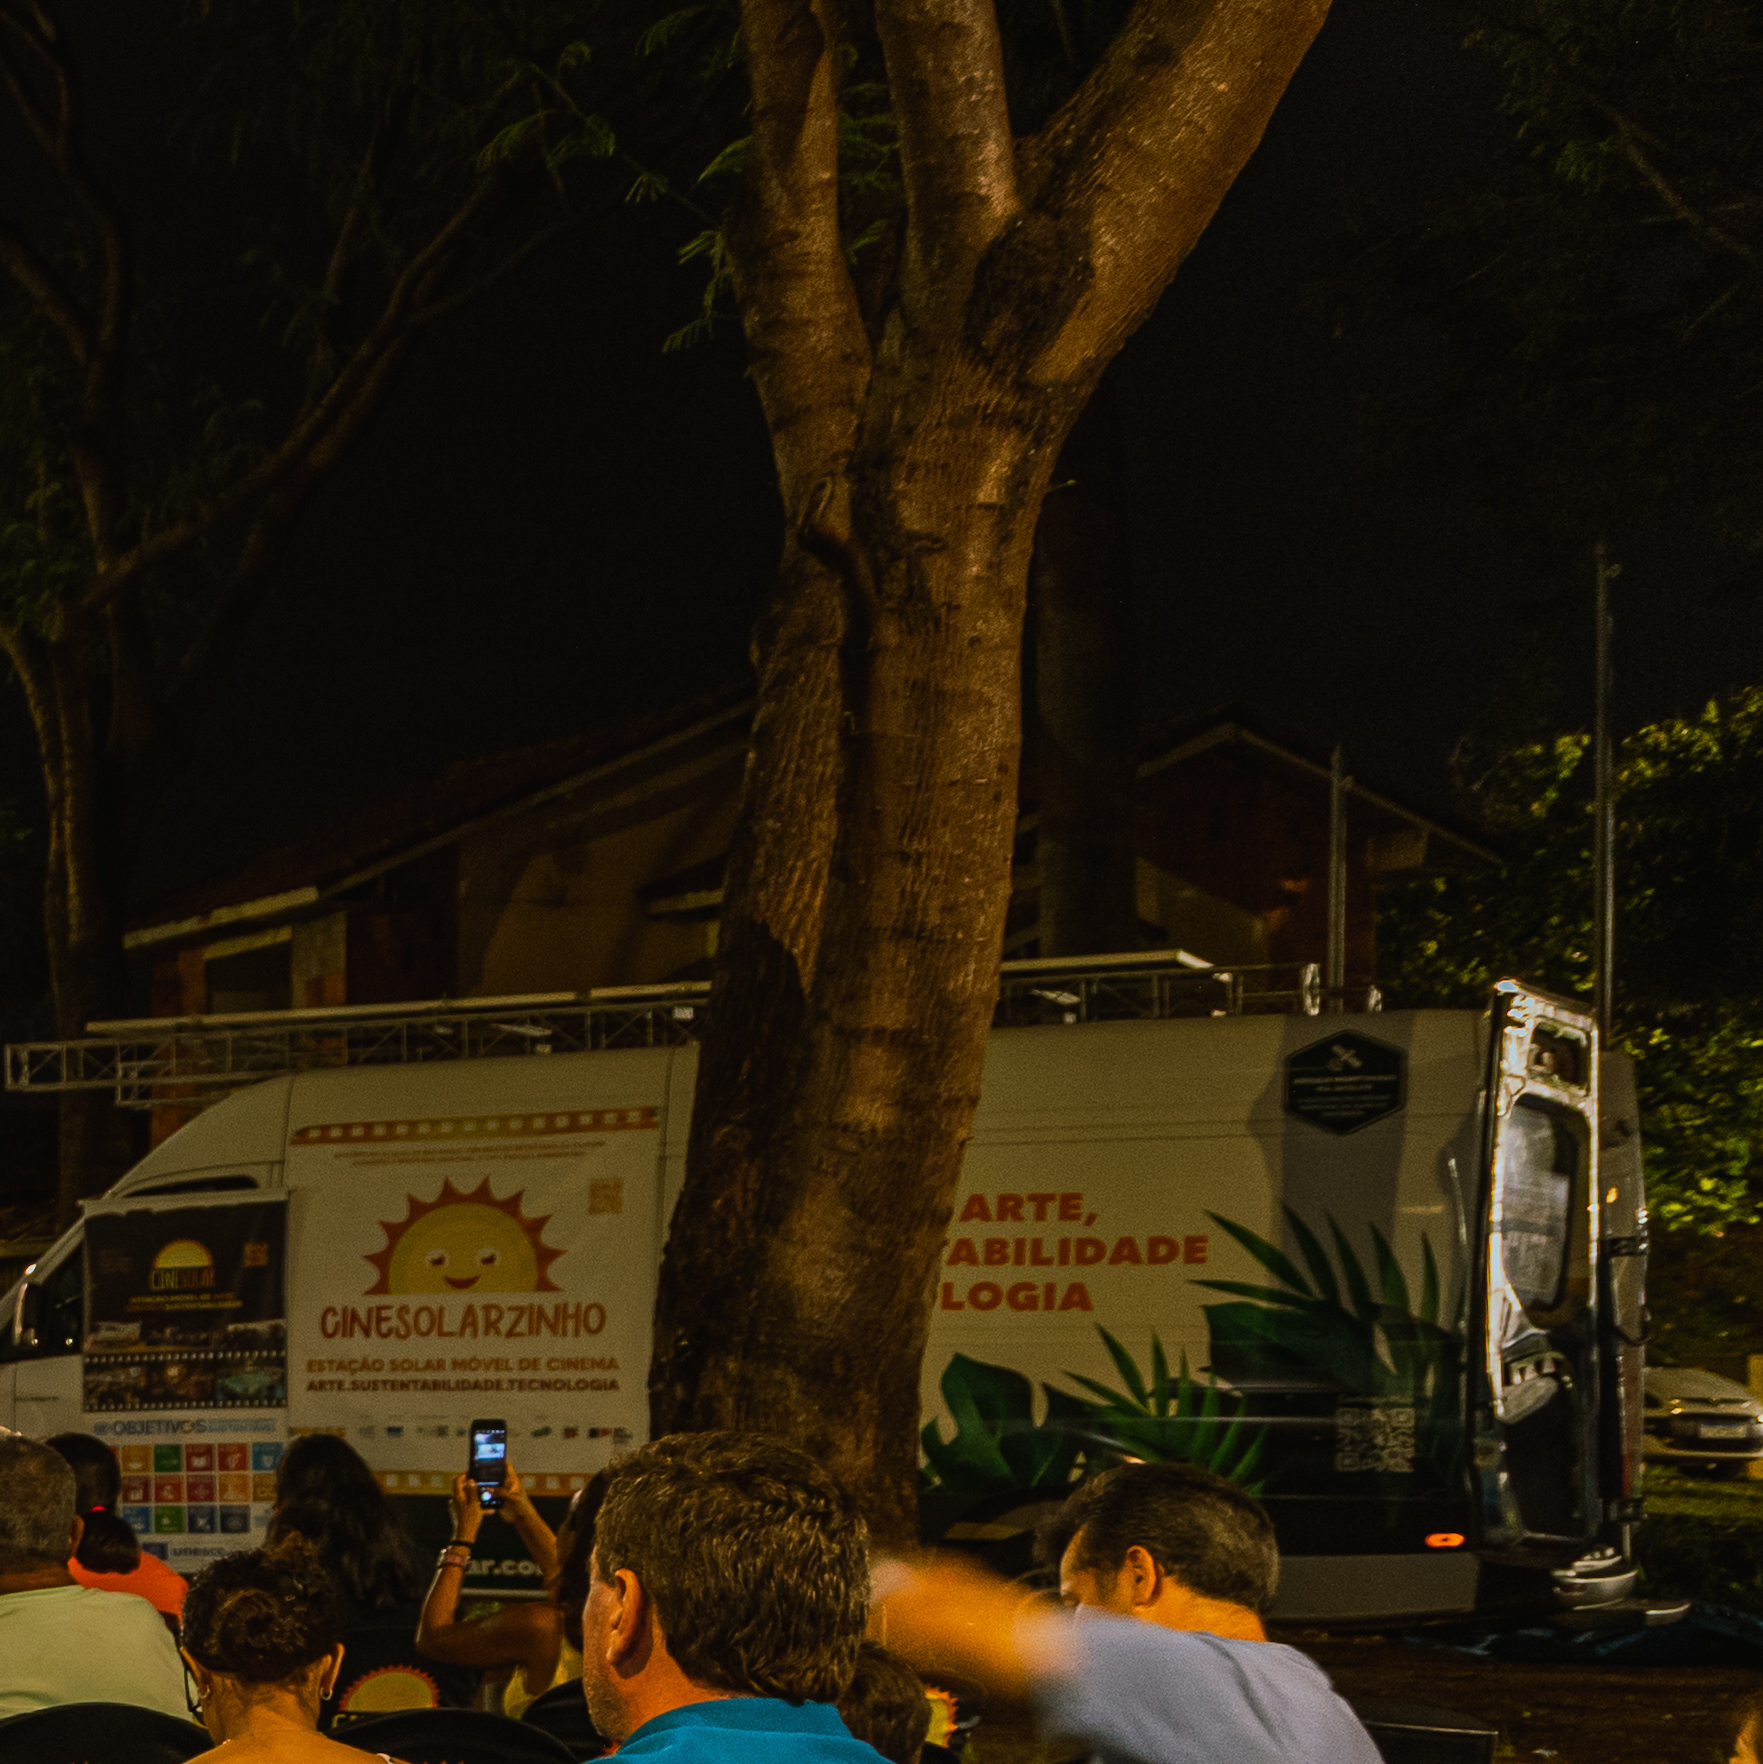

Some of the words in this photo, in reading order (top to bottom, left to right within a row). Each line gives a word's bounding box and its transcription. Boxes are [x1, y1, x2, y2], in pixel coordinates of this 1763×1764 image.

[958, 1192, 1098, 1227] ARTE,
[944, 1235, 1209, 1267] ABILIDADE
[940, 1281, 1095, 1312] LOGIA
[320, 1302, 607, 1340] CINESOLARZINHO
[306, 1357, 385, 1376] ESTAÇÃO
[390, 1359, 446, 1373] SOLAR
[452, 1356, 512, 1372] MÓVEL
[518, 1357, 540, 1371] DE
[546, 1357, 620, 1371] CINEMA
